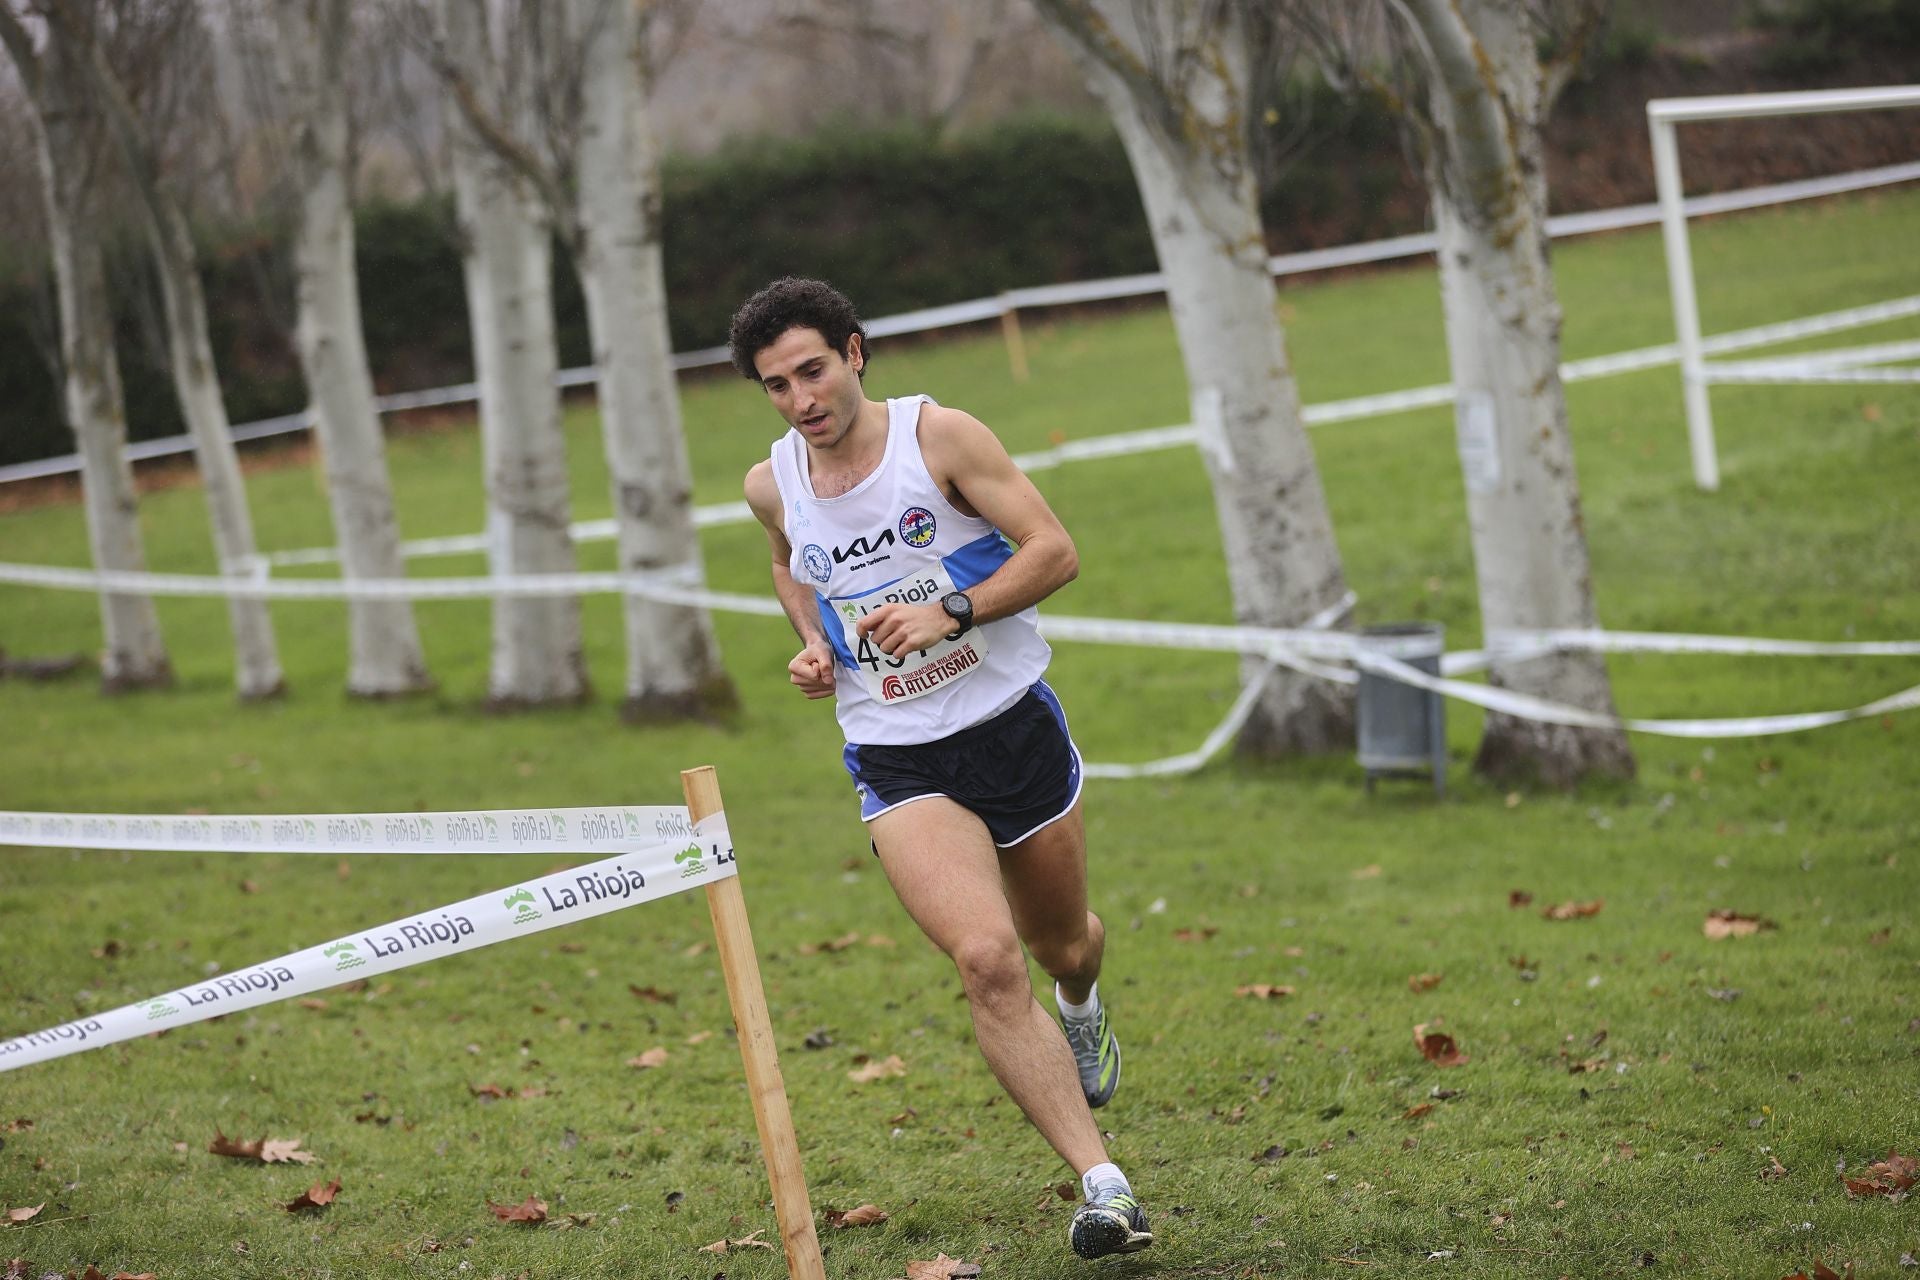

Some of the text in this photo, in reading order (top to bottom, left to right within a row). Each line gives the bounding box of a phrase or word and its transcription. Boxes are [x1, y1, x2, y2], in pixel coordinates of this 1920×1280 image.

[832, 528, 895, 564] KIA
[901, 642, 972, 681] FEDERACIÓN RIOJANA DE
[905, 649, 979, 694] ATLETISMO
[542, 865, 645, 912] La Rioja
[363, 914, 475, 958] La Rioja
[178, 966, 295, 1006] La Rioja
